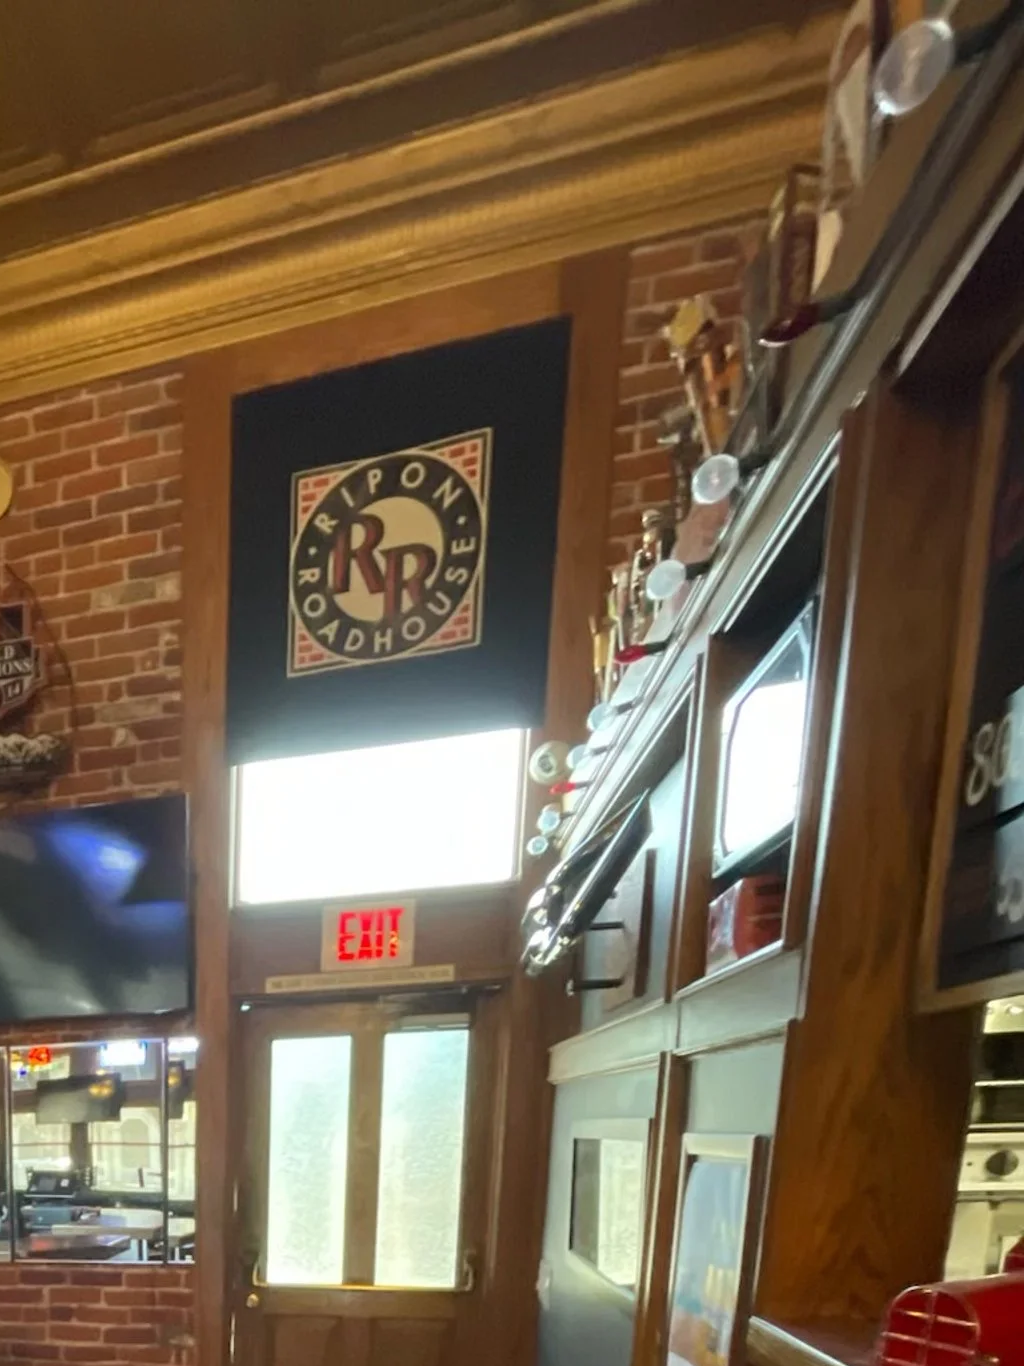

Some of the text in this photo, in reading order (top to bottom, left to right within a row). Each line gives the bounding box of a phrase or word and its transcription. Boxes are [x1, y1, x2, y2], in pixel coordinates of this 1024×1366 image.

[314, 461, 464, 534] RIPON
[297, 536, 476, 654] ROADHOUSE
[337, 907, 405, 962] EXIT
